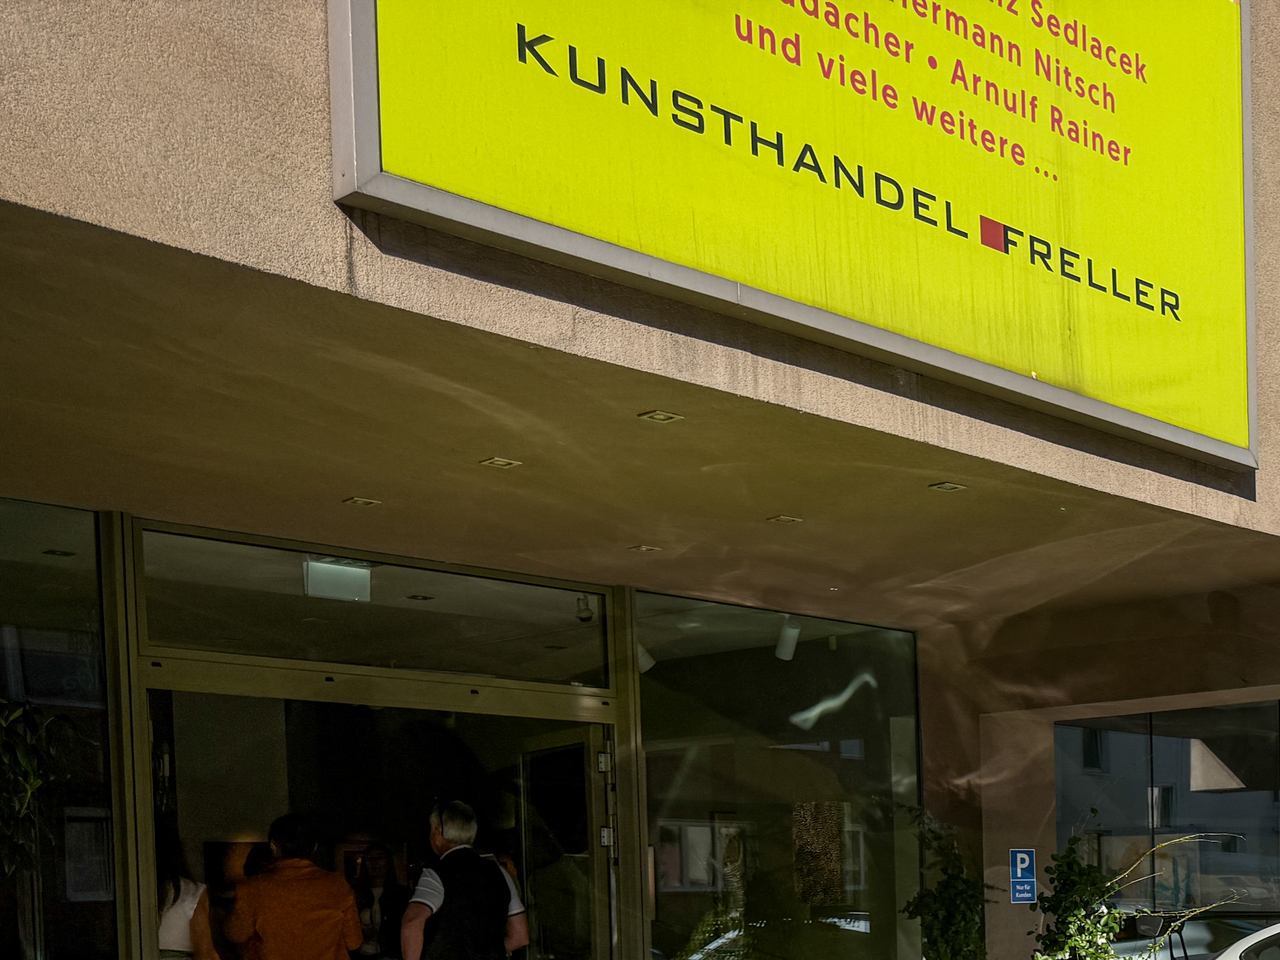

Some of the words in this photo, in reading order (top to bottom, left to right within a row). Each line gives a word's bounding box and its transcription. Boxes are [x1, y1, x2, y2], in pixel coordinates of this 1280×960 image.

[734, 13, 802, 67] und
[816, 51, 899, 109] viele
[911, 95, 1026, 167] weitere
[782, 0, 915, 64] dacher
[950, 58, 1039, 123] Arnulf
[1050, 105, 1132, 166] Rainer
[889, 0, 1022, 67] ermann
[1034, 48, 1116, 114] Nitsch
[1030, 0, 1148, 83] Sedlacek
[516, 22, 970, 239] KUNSTHANDEL
[1003, 225, 1182, 322] FRELLER
[1016, 853, 1030, 877] P
